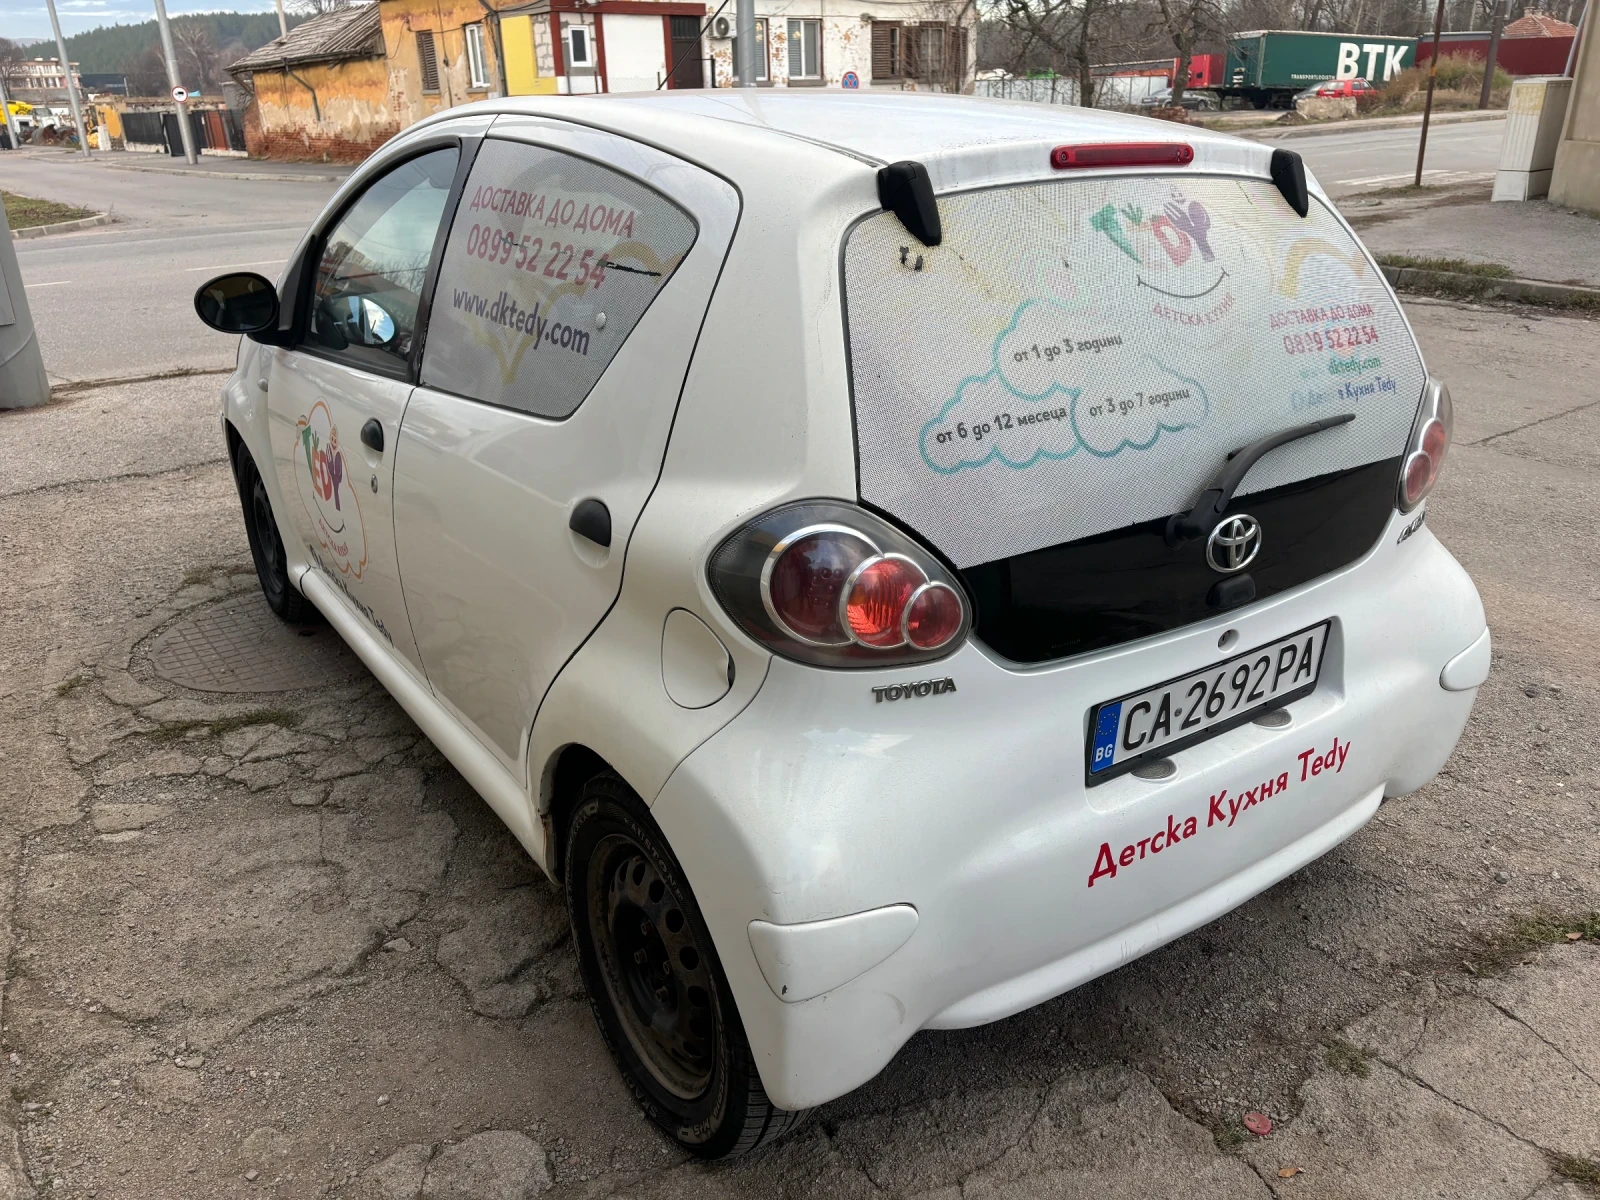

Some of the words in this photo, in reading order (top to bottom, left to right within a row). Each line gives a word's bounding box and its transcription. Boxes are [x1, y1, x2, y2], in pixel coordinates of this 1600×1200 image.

[1336, 42, 1409, 82] BTK
[470, 185, 545, 221] ДОСТАВКА
[545, 198, 575, 228] ДО
[573, 203, 636, 239] ДОМА
[467, 223, 514, 266] 0899
[515, 235, 544, 273] 52
[543, 241, 574, 281] 22
[574, 249, 609, 289] 54
[453, 288, 591, 356] www.dktedy.com
[1269, 307, 1328, 331] ДОСТАВКА
[1330, 305, 1345, 322] ДО
[1346, 302, 1375, 321] ДОМА
[1013, 350, 1031, 363] от
[1032, 343, 1041, 360] 1
[1045, 345, 1062, 362] до
[1063, 338, 1075, 354] 3
[1077, 334, 1123, 354] години
[1325, 328, 1344, 349] 52
[1344, 326, 1363, 347] 22
[1362, 325, 1379, 344] 54
[1089, 404, 1107, 418] от
[1107, 397, 1117, 414] 3
[1119, 399, 1135, 416] до
[1135, 392, 1145, 408] 7
[1148, 388, 1191, 408] години
[936, 431, 954, 445] от
[956, 422, 968, 439] 6
[972, 422, 991, 441] до
[993, 413, 1014, 431] 12
[1017, 407, 1068, 427] месеца
[872, 676, 957, 703] TOYOTA
[1094, 743, 1114, 763] BG
[1088, 814, 1197, 888] Детска
[1207, 770, 1289, 828] Кухня
[1297, 737, 1351, 782] Tedy
